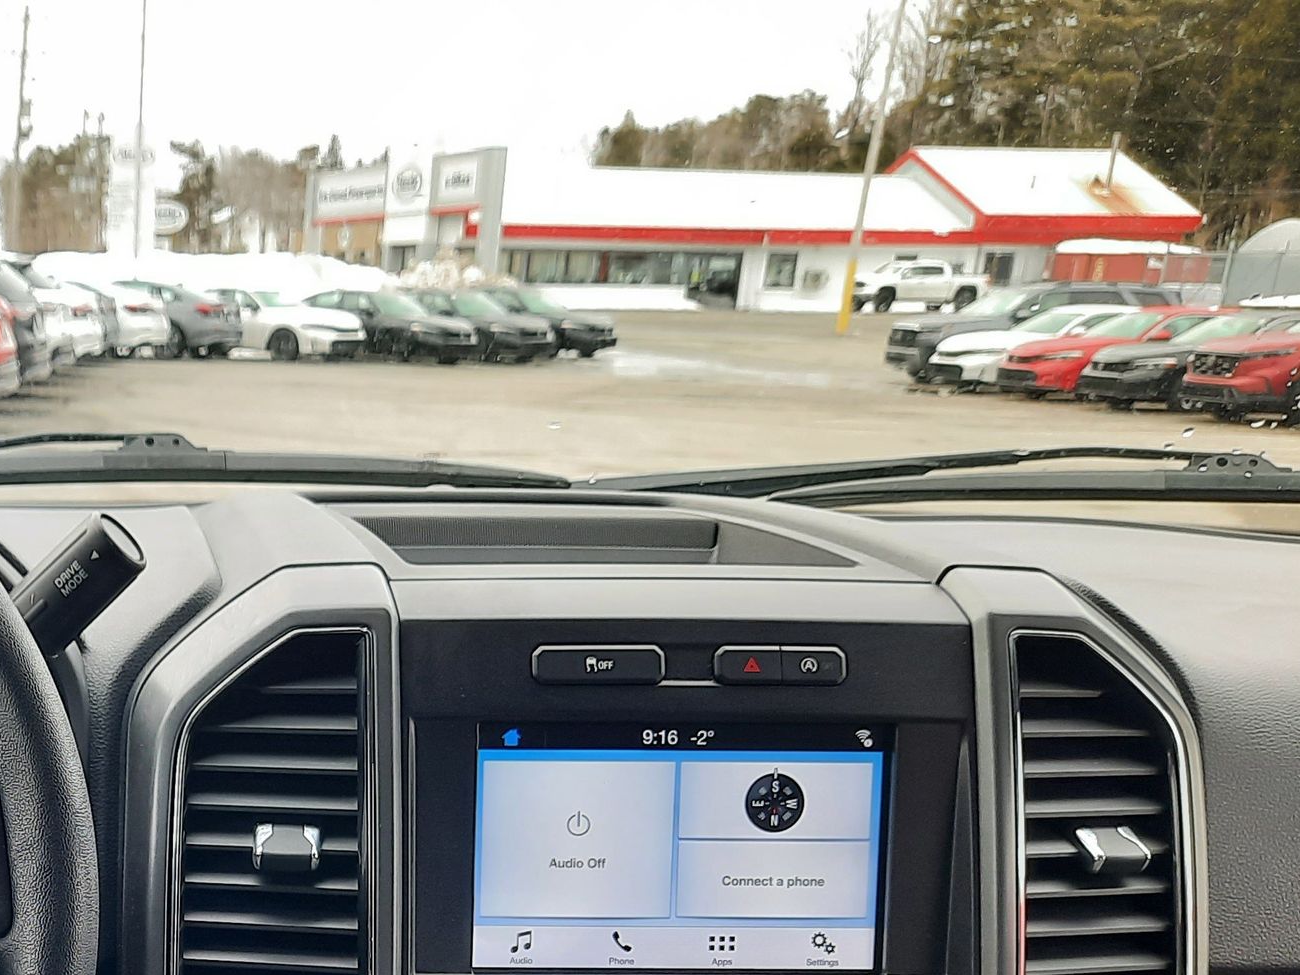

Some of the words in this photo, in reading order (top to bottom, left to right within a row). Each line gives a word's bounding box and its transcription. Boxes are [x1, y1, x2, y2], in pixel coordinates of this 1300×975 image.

[54, 560, 82, 588] DRIVE
[60, 569, 89, 598] MODE
[597, 660, 614, 670] OFF
[641, 729, 679, 745] 9:16
[548, 858, 583, 870] Audio
[586, 858, 606, 870] Off
[721, 875, 773, 888] Connect
[776, 879, 784, 888] a
[787, 876, 826, 891] phone
[508, 957, 534, 967] Audio
[608, 957, 635, 967] Phone
[711, 957, 733, 969] Apps
[805, 957, 840, 969] Settings
